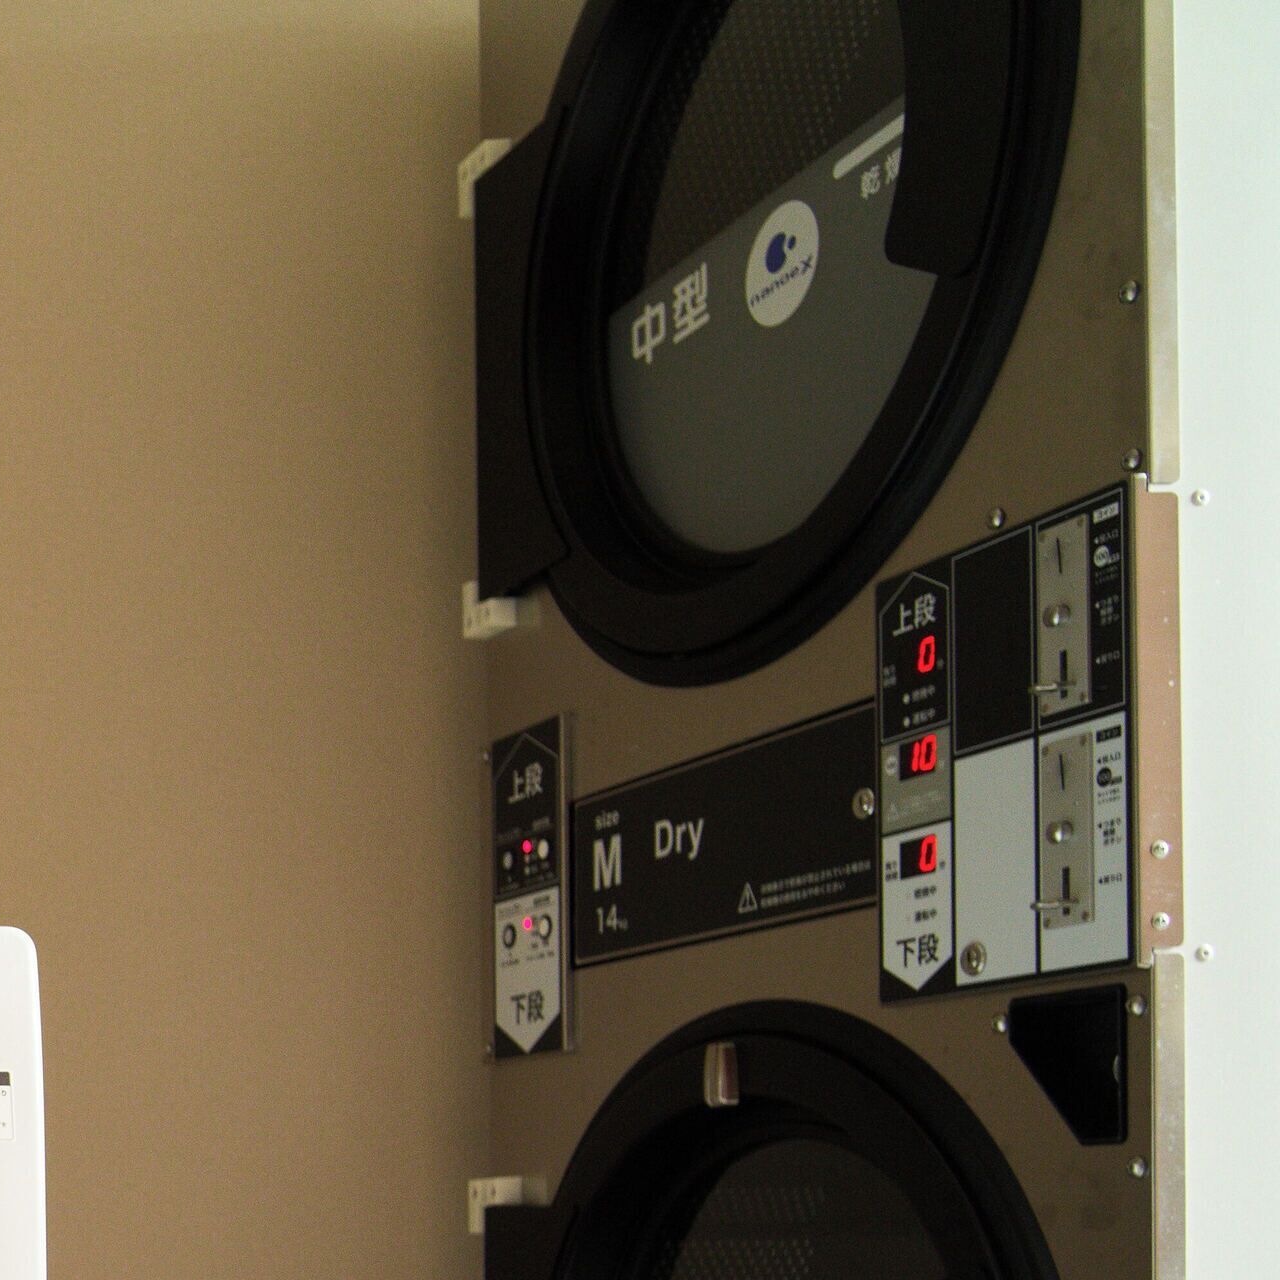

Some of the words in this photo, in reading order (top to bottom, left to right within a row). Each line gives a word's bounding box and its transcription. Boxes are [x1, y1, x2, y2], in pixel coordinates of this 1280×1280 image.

[631, 262, 709, 365] 中型
[892, 592, 936, 637] 上段
[917, 635, 935, 673] 0
[911, 734, 937, 772] 10
[508, 761, 543, 804] 上段
[655, 818, 704, 860] Dry
[918, 834, 937, 873] 0
[593, 833, 622, 892] M
[896, 933, 939, 968] 下段
[510, 990, 544, 1025] 下段
